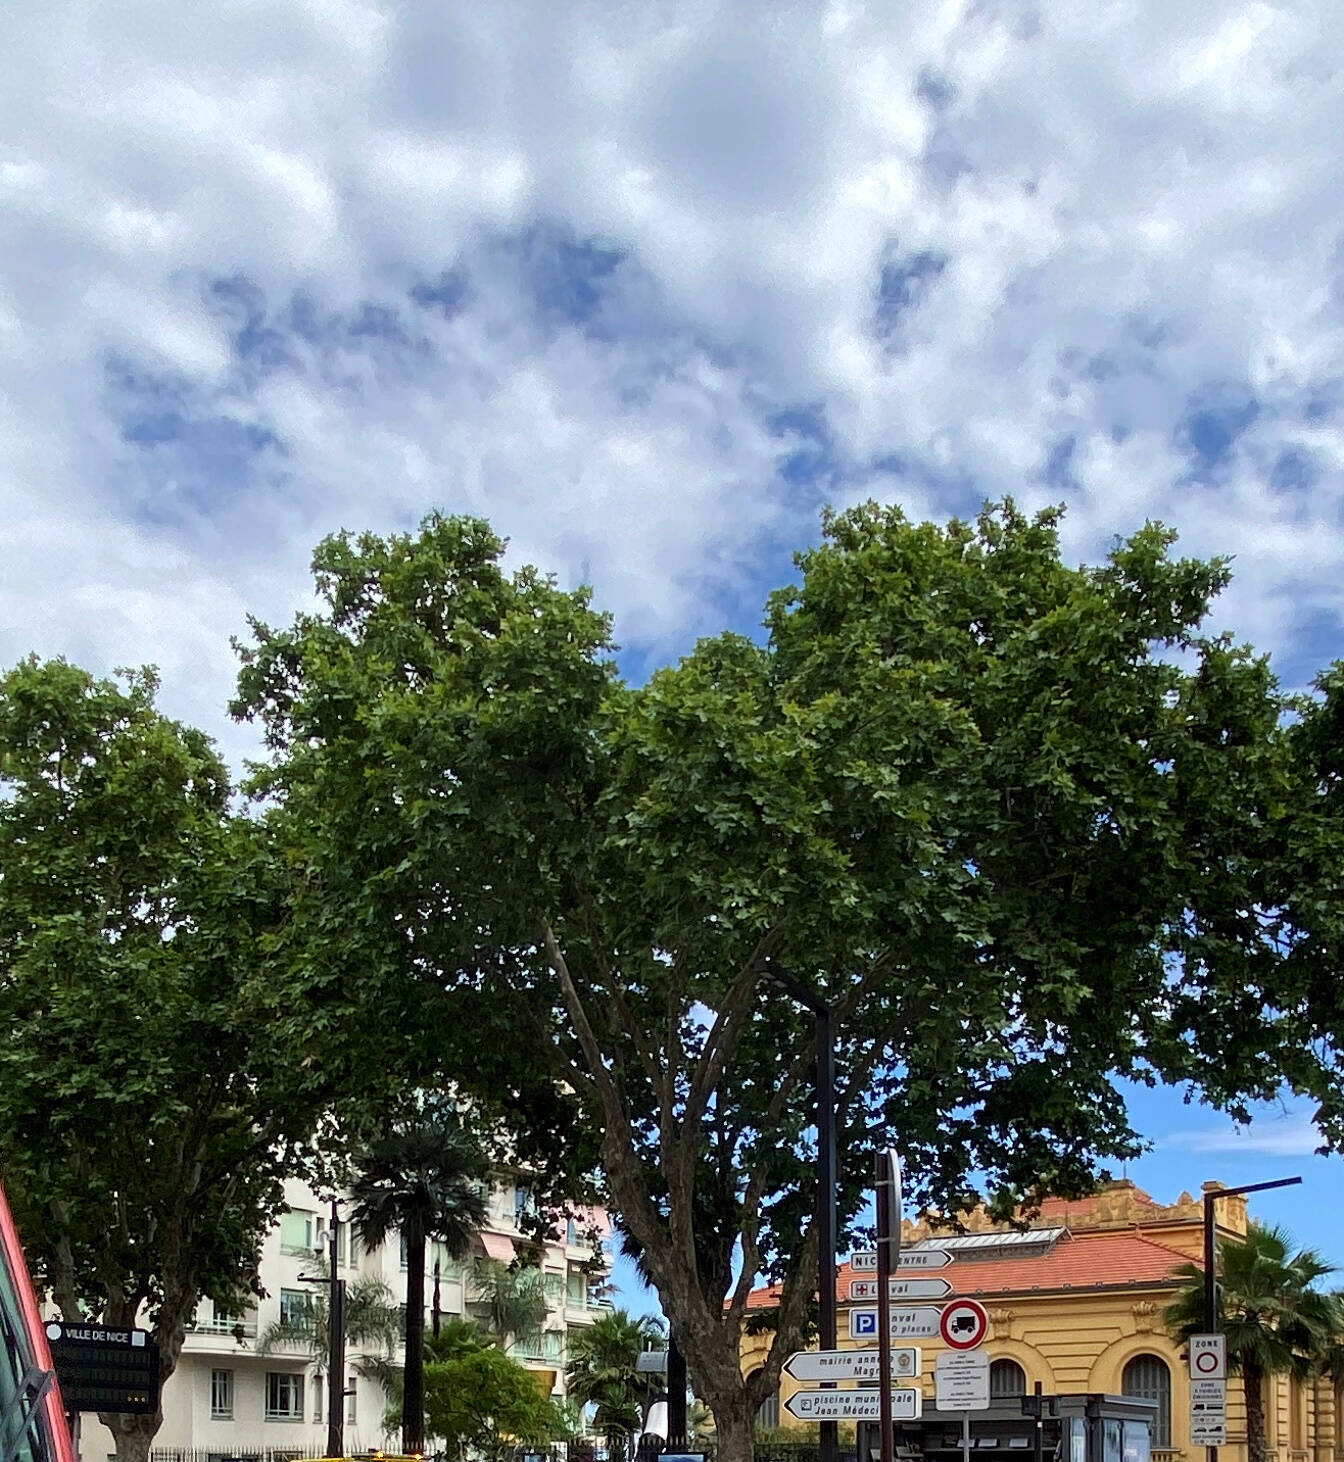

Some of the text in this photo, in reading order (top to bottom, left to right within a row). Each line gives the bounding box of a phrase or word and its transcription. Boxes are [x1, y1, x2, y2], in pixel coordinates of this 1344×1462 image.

[898, 1255, 928, 1265] ENTRE
[871, 1284, 909, 1294] Lval
[859, 1316, 872, 1332] P
[65, 1328, 129, 1343] VILLE DE NICE
[1195, 1340, 1218, 1348] ZONE
[819, 1355, 894, 1366] mairie anne
[853, 1366, 894, 1377] Magn
[814, 1394, 912, 1406] piscine munipale
[814, 1405, 879, 1415] Jean Médeci
